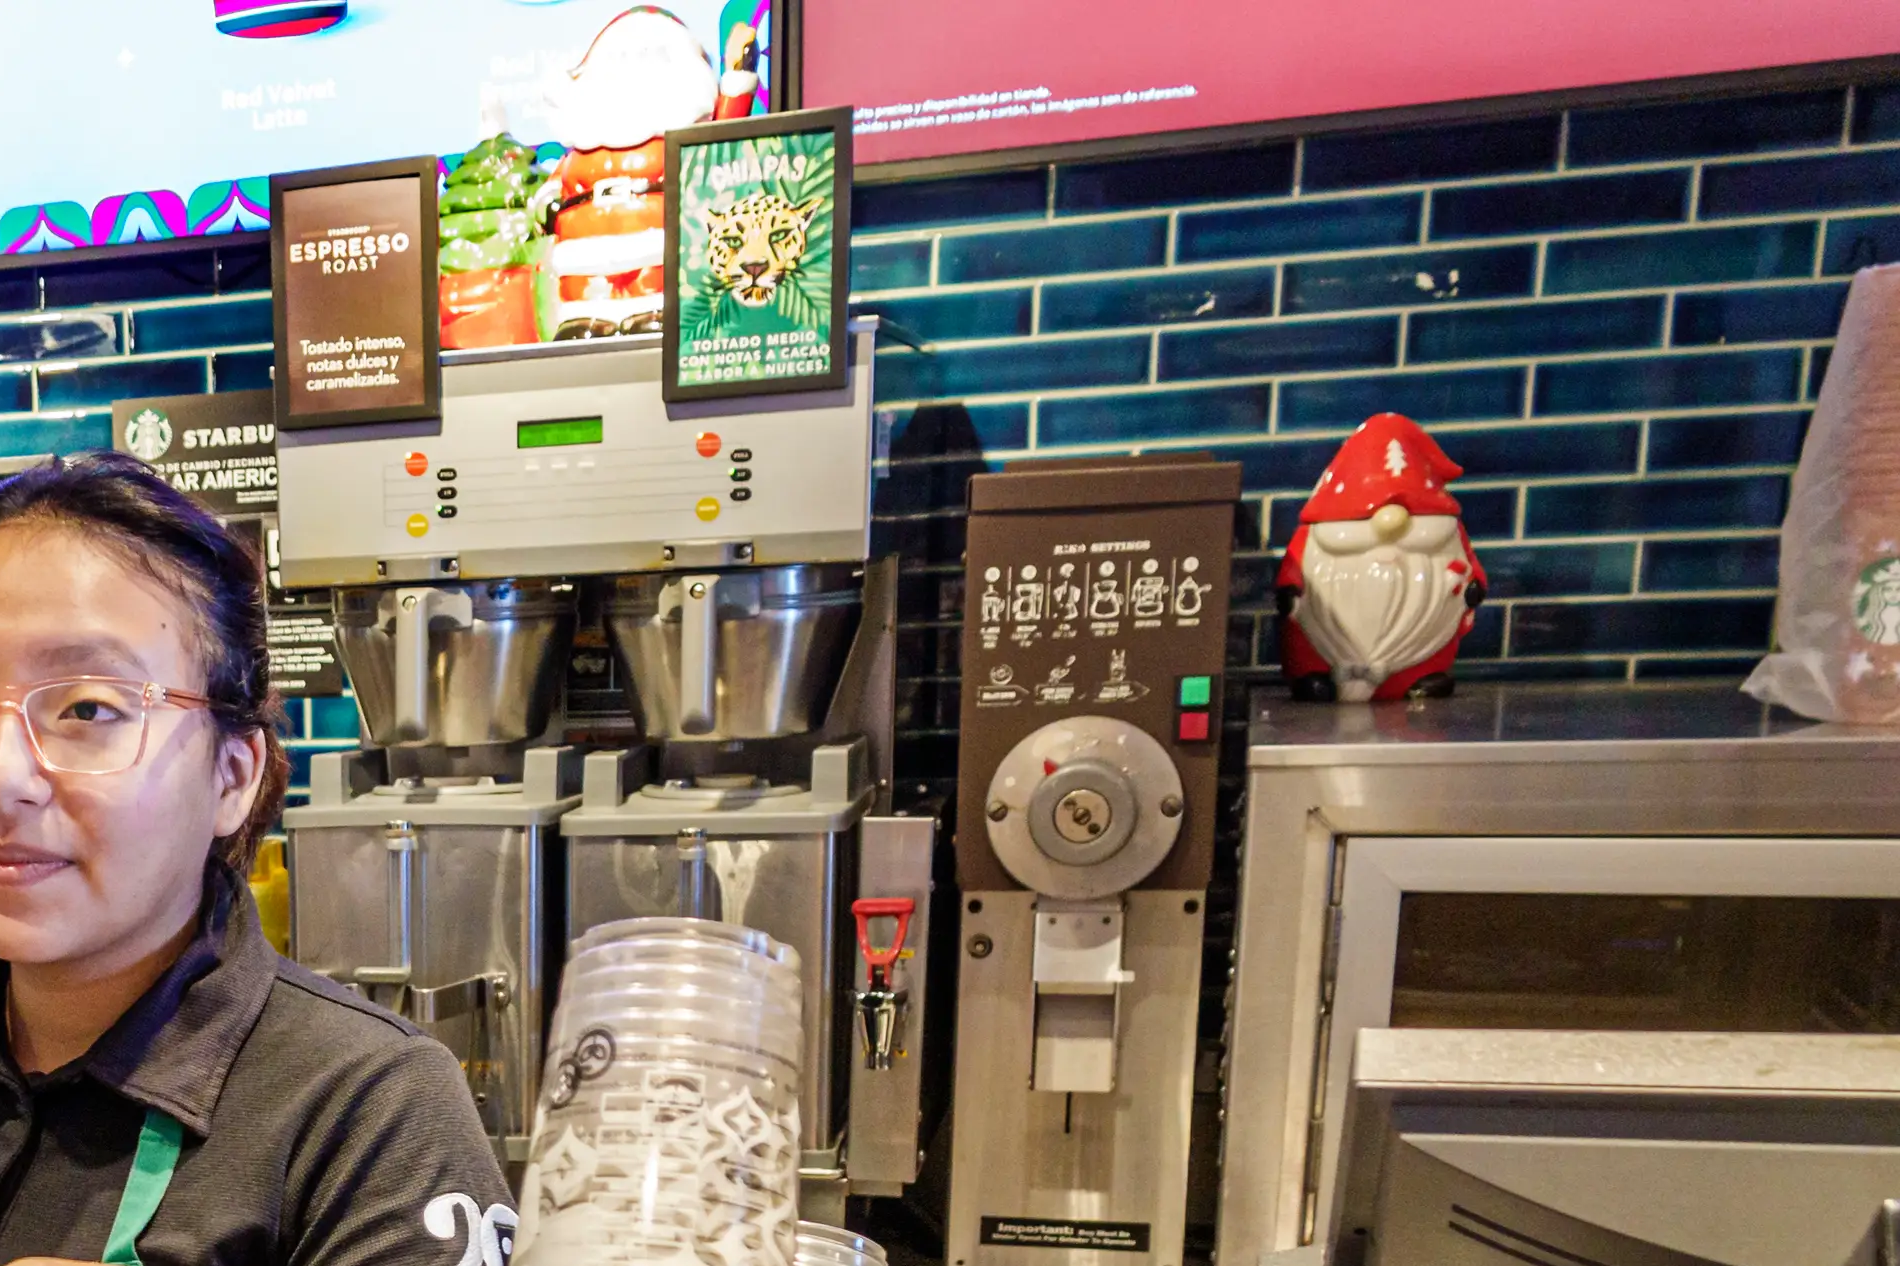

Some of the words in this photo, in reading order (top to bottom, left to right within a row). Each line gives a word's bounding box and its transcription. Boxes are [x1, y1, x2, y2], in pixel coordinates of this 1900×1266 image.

[875, 103, 913, 119] precios
[922, 92, 997, 113] disponibilidad
[999, 91, 1012, 102] en
[976, 108, 990, 121] de
[710, 154, 807, 190] CHIAPAS
[289, 232, 410, 263] ESPRESSO
[322, 256, 379, 274] ROAST
[300, 336, 352, 356] Tostado
[355, 336, 405, 350] intenso,
[692, 335, 760, 353] TOSTADO
[766, 330, 816, 346] MEDIO
[306, 358, 343, 373] notas
[346, 353, 388, 370] dulces
[390, 354, 399, 370] y
[679, 354, 710, 368] CON
[714, 351, 761, 366] NOTAS
[766, 349, 776, 360] A
[780, 344, 830, 358] CACAO
[306, 369, 400, 392] caramelizadas.
[680, 370, 689, 382] Y
[696, 366, 744, 381] SABOR
[750, 364, 759, 376] A
[765, 359, 828, 376] NUECES.
[182, 424, 275, 448] STARBU
[166, 463, 180, 473] DE
[181, 460, 221, 472] CAMBIO
[201, 467, 277, 490] AMERIC
[998, 1222, 1074, 1236] Important:
